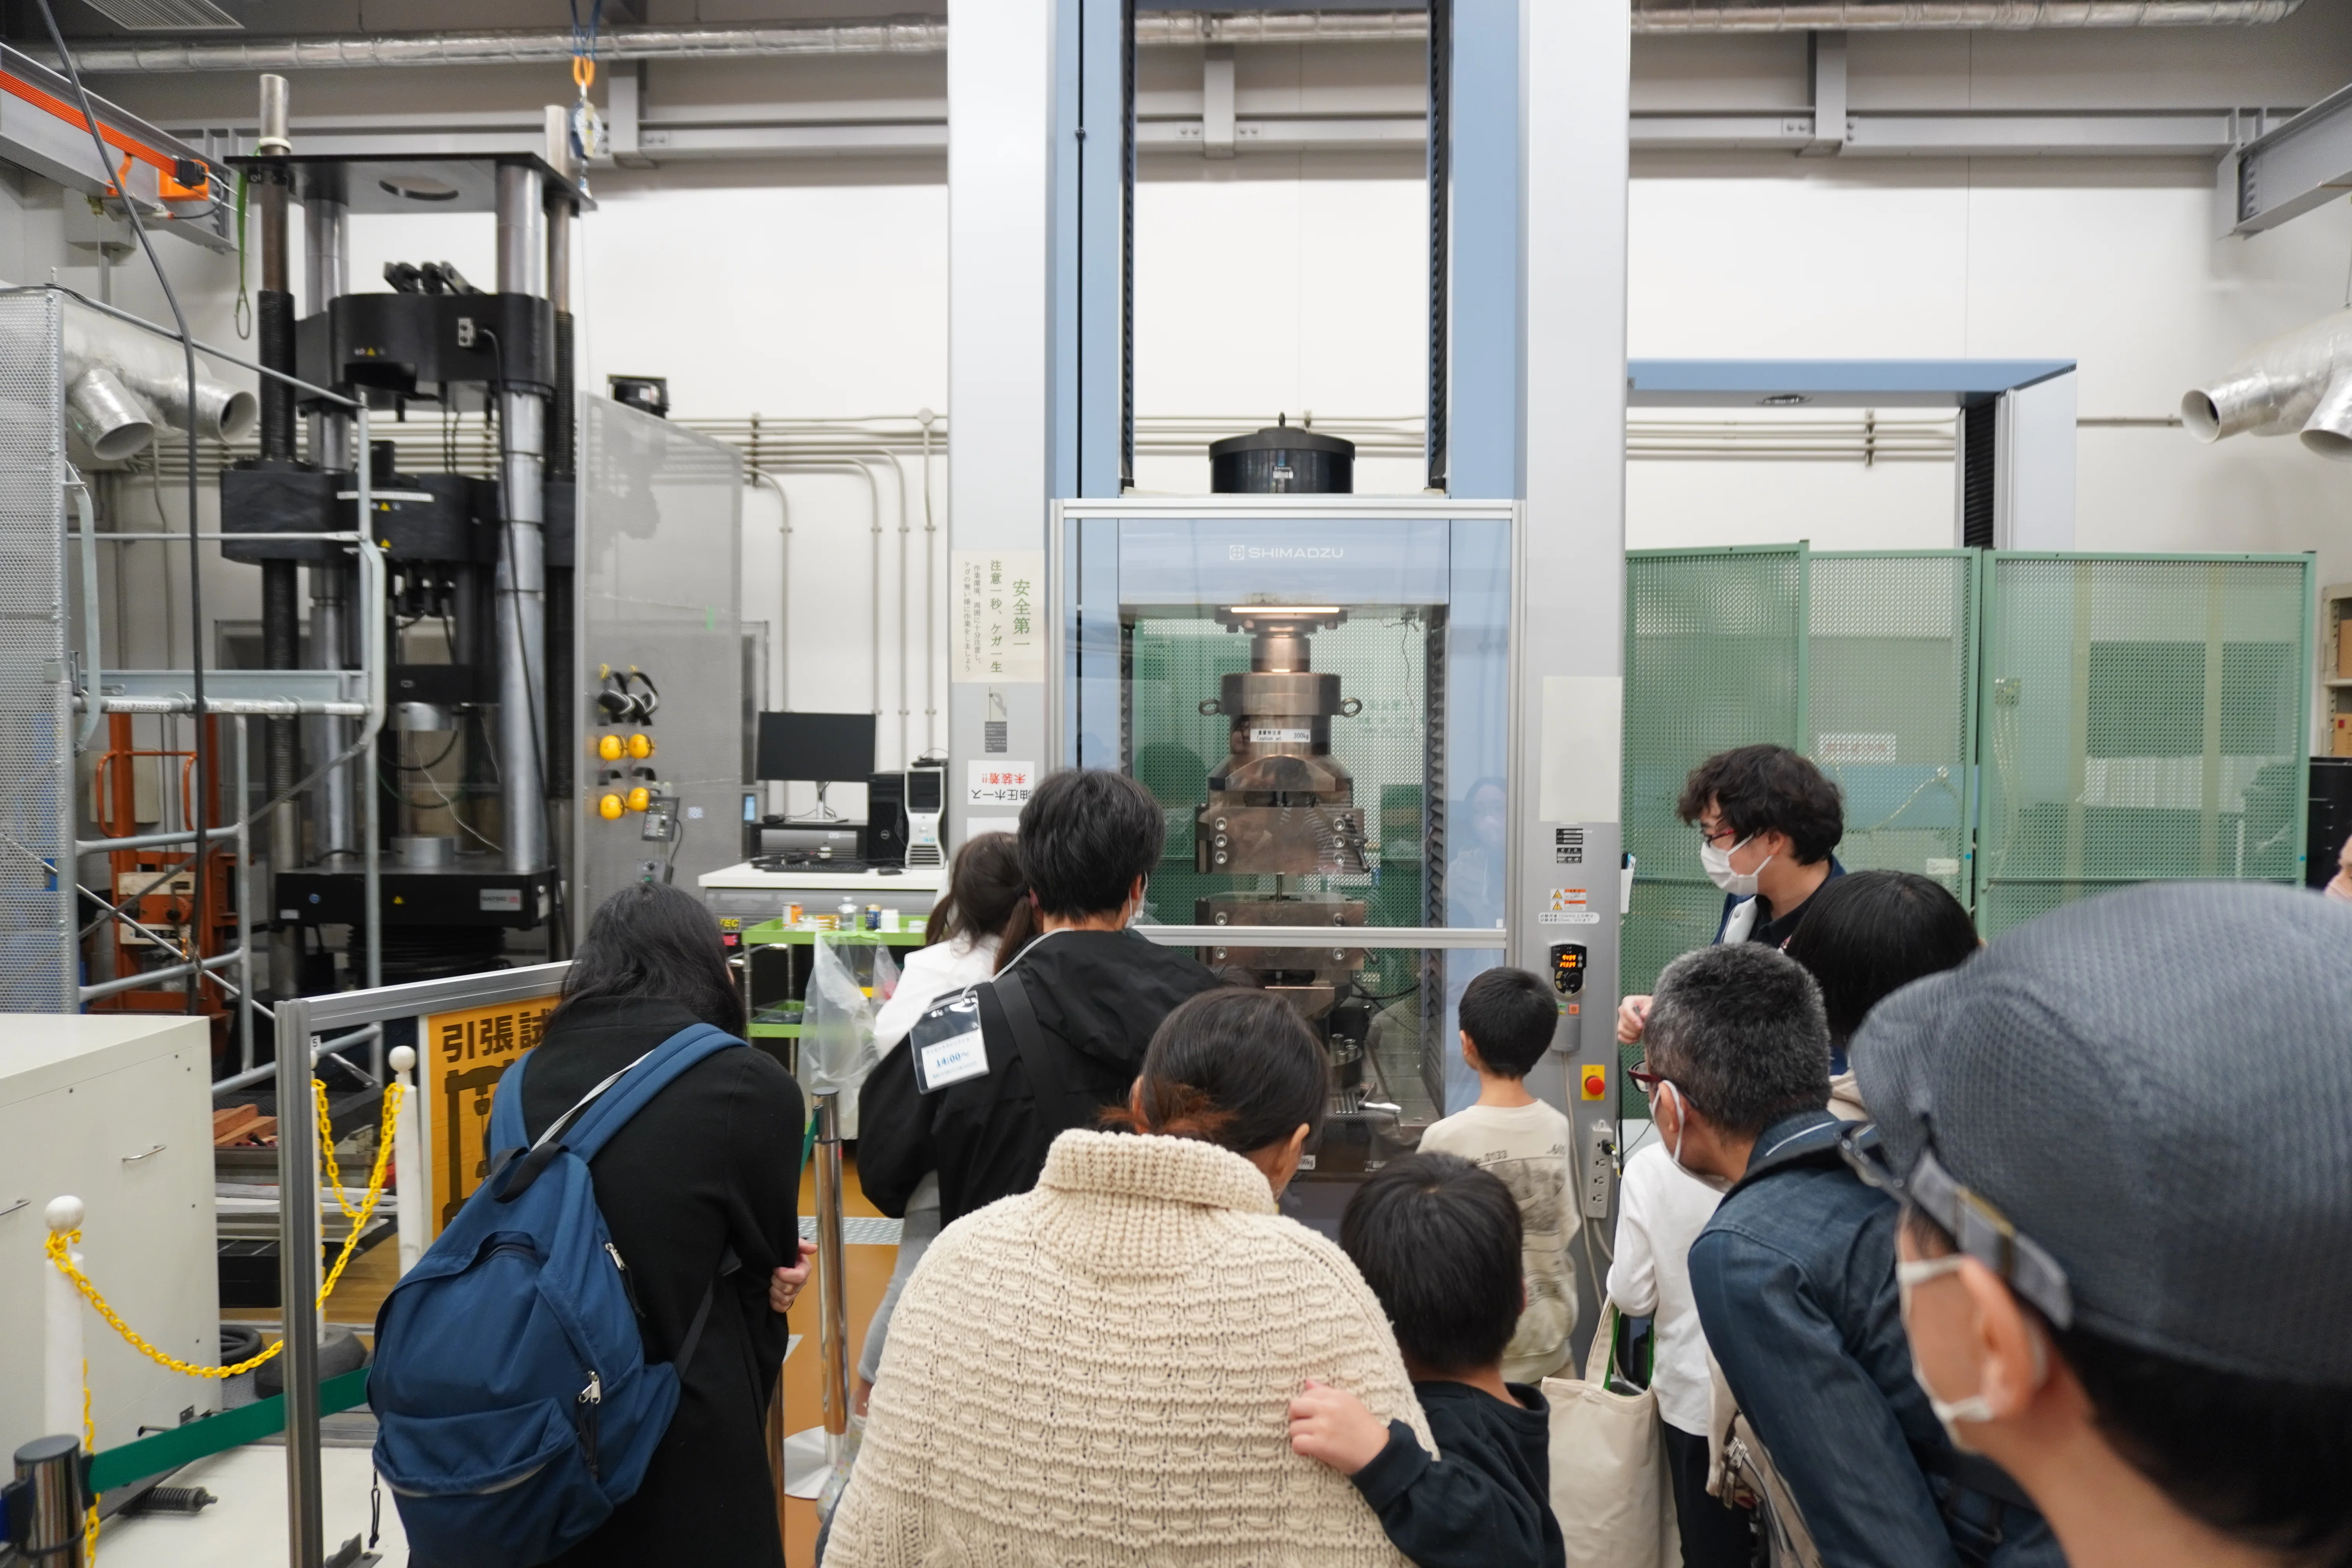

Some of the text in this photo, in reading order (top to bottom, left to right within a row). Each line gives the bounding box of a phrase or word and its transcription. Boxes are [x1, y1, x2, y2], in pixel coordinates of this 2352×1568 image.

[1248, 547, 1343, 558] SHIMADZU
[990, 560, 1002, 673] 注意一秒、 ケガ一生
[1013, 579, 1031, 645] 安全第一
[982, 772, 1026, 785] 未装着!!
[971, 789, 1031, 801] 油圧ホース
[312, 1038, 318, 1047] 5
